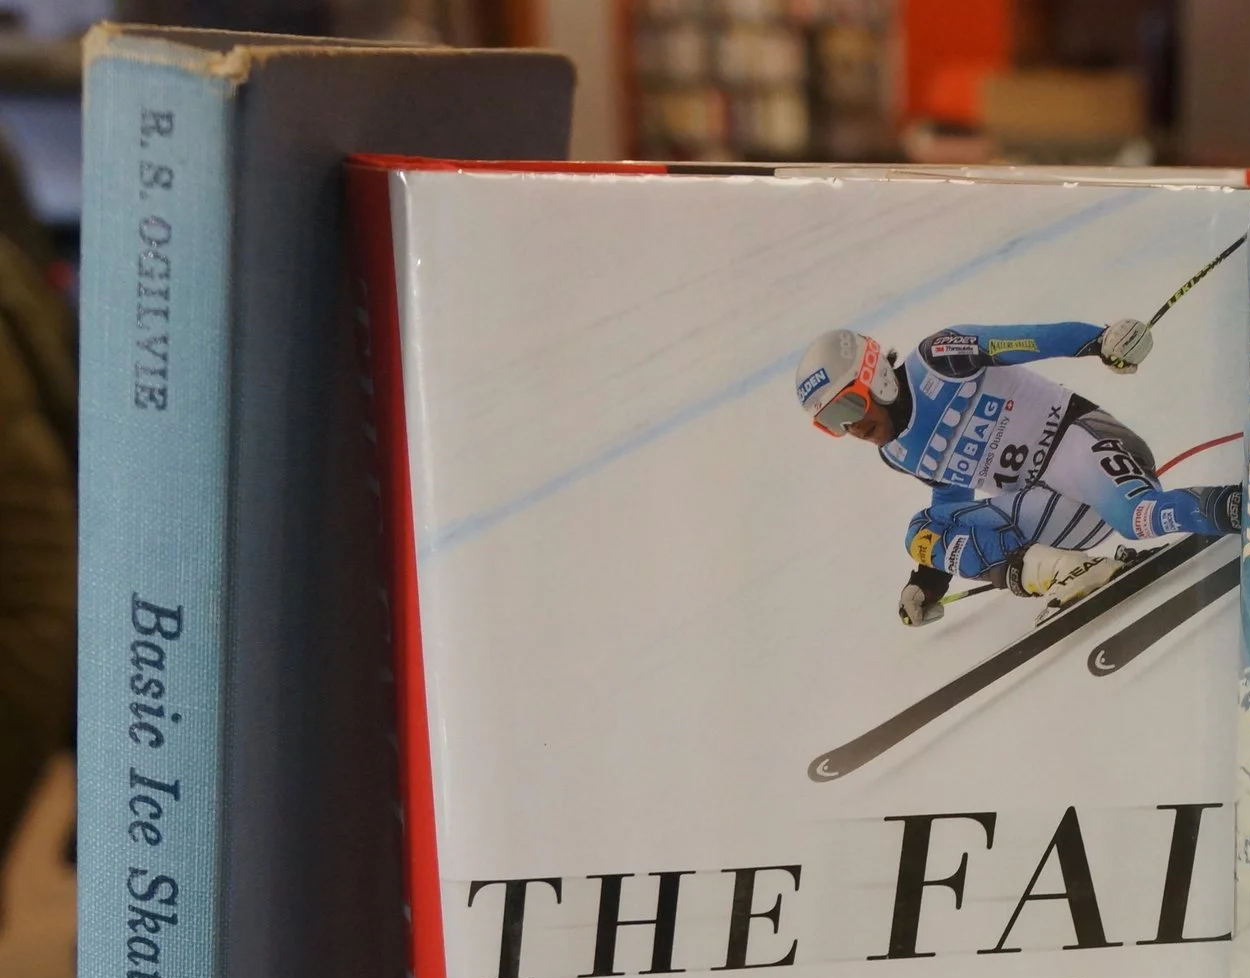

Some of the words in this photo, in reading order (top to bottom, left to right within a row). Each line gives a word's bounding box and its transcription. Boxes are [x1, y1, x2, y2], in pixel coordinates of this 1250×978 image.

[133, 214, 172, 411] OGILVIE
[934, 335, 977, 345] SPYDER
[990, 415, 1010, 450] Quality
[993, 443, 1029, 489] 18
[1091, 438, 1151, 499] USA
[129, 591, 184, 750] Basic
[127, 767, 181, 847] Ice
[866, 803, 1232, 961] FAL
